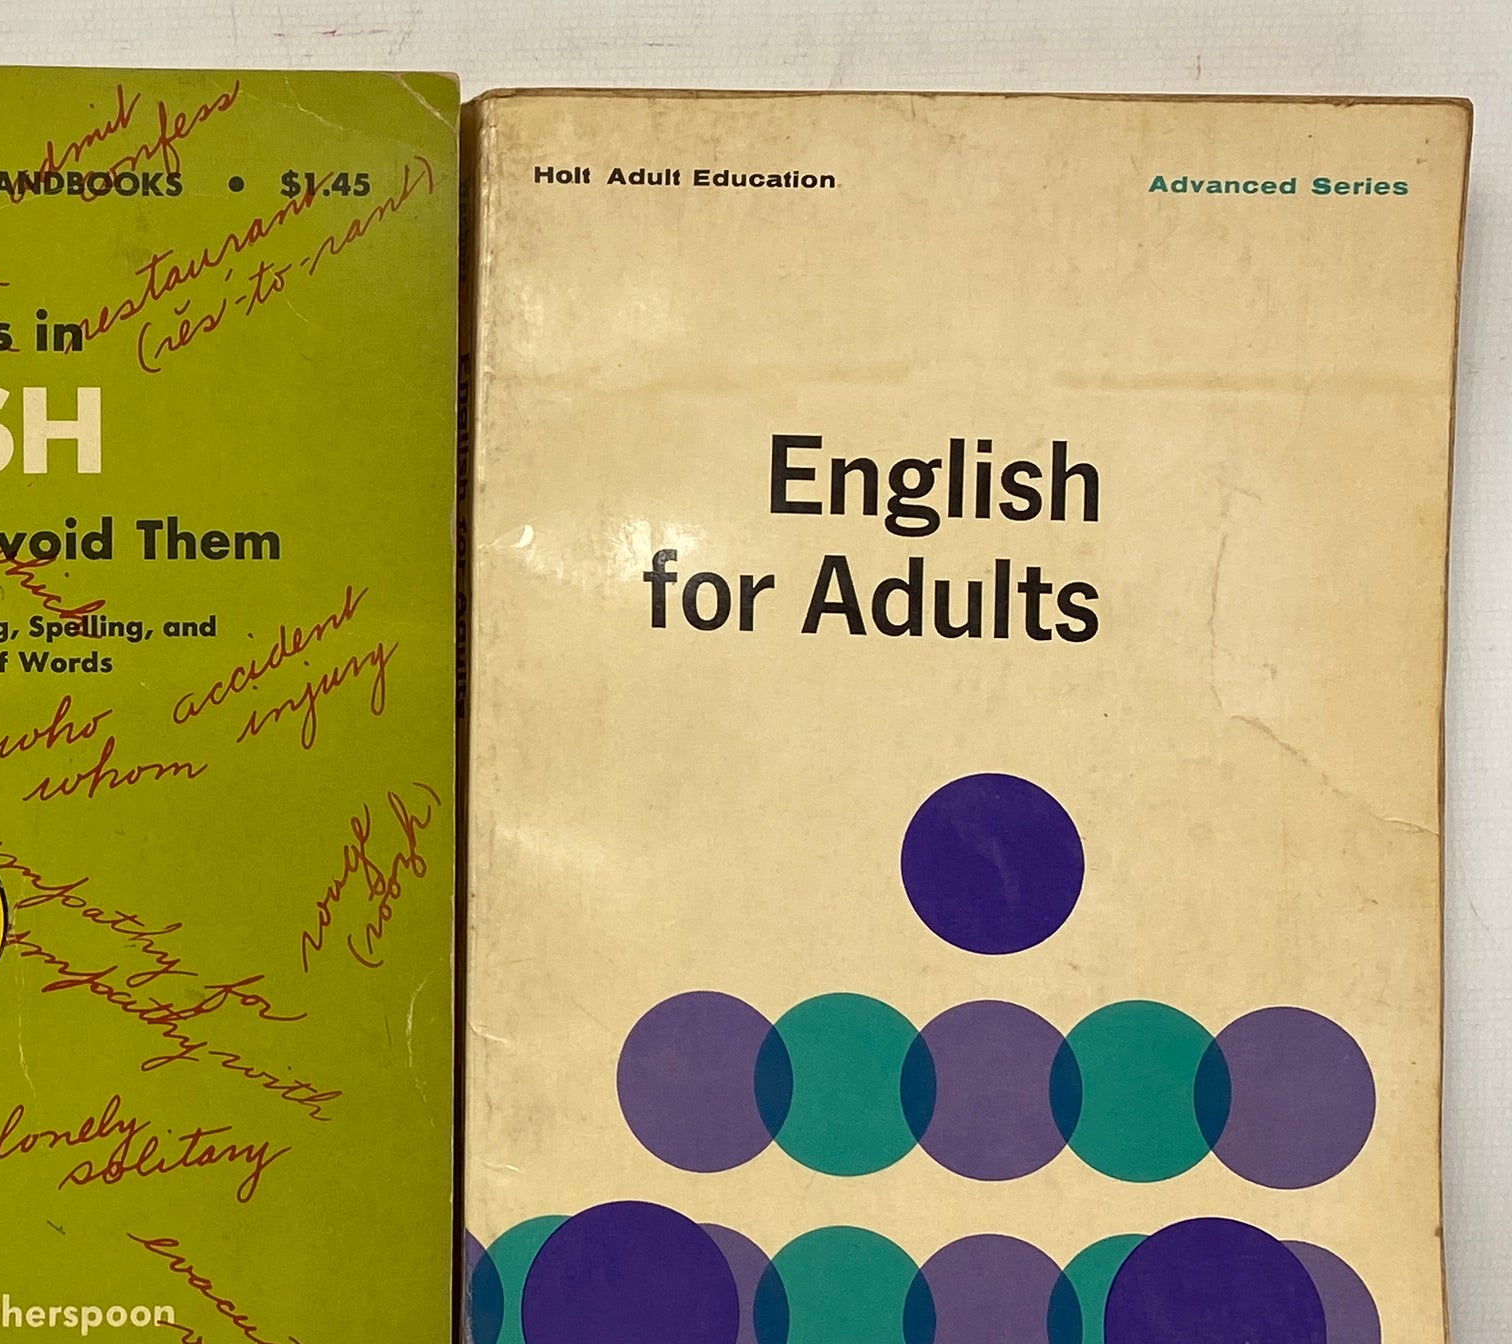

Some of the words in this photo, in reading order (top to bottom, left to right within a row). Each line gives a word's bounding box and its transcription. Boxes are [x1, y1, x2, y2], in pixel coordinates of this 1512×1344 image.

[10, 84, 141, 204] admit
[81, 79, 240, 202] confess
[280, 169, 371, 198] $1.45
[534, 166, 591, 184] Holt
[607, 167, 681, 186] Adult
[693, 169, 836, 188] Education
[1148, 175, 1297, 194] Advanced
[1311, 177, 1409, 195] Series
[65, 172, 334, 355] restaurant
[35, 308, 84, 352] in
[769, 433, 1100, 538] English
[136, 516, 281, 561] Them
[28, 615, 154, 642] Spelling,
[163, 615, 216, 638] and
[643, 549, 777, 633] for
[800, 553, 1100, 644] Adults
[19, 651, 113, 674] Words
[172, 585, 369, 724] accident
[236, 641, 399, 750] injury
[23, 737, 208, 802] whom
[158, 975, 308, 1023] for
[209, 1050, 343, 1122] with
[58, 1125, 292, 1204] solitary
